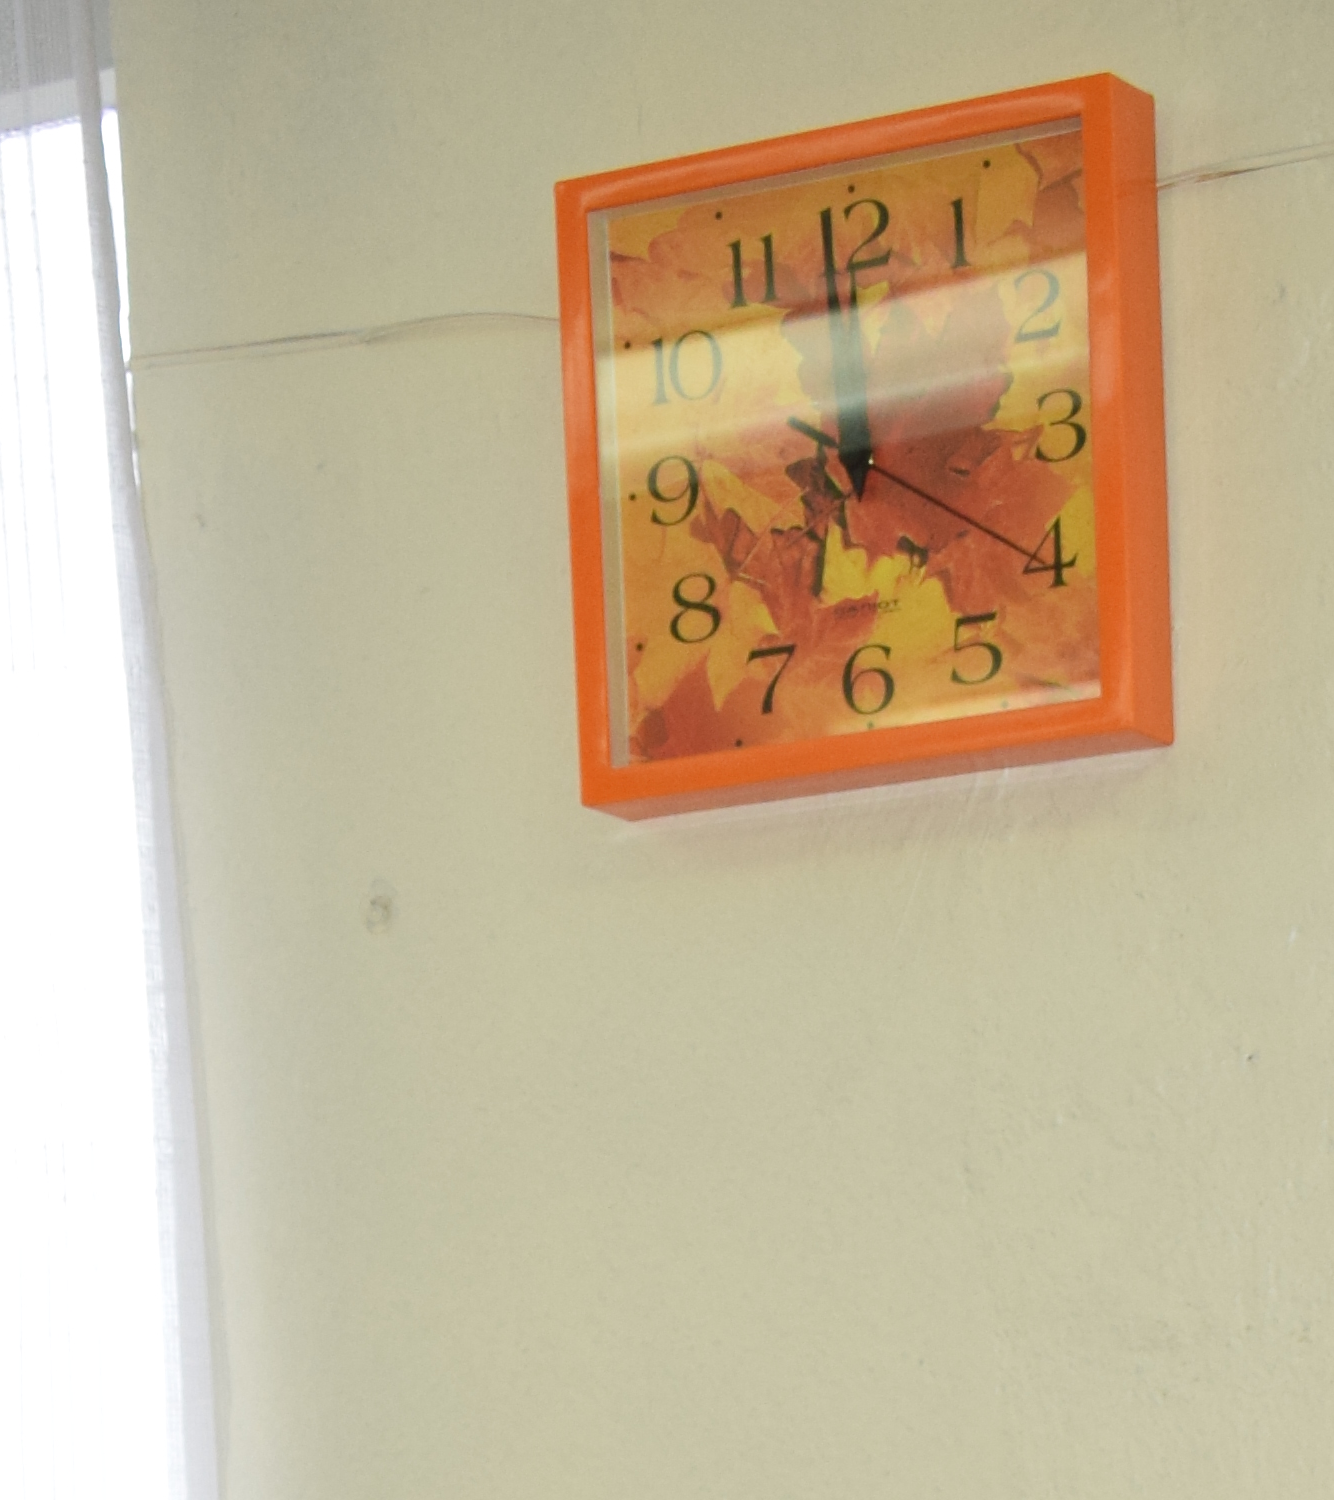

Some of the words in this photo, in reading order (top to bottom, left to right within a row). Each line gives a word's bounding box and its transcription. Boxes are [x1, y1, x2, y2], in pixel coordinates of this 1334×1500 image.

[952, 200, 972, 269] 1
[728, 235, 777, 308] 11
[1014, 270, 1061, 343] 2
[651, 330, 723, 405] 10
[1035, 389, 1087, 463] 3
[647, 455, 700, 527] 9
[1023, 520, 1077, 588] 4
[670, 573, 722, 643] 8
[747, 645, 796, 715] 7
[842, 645, 896, 715] 6
[951, 612, 1002, 685] 5
